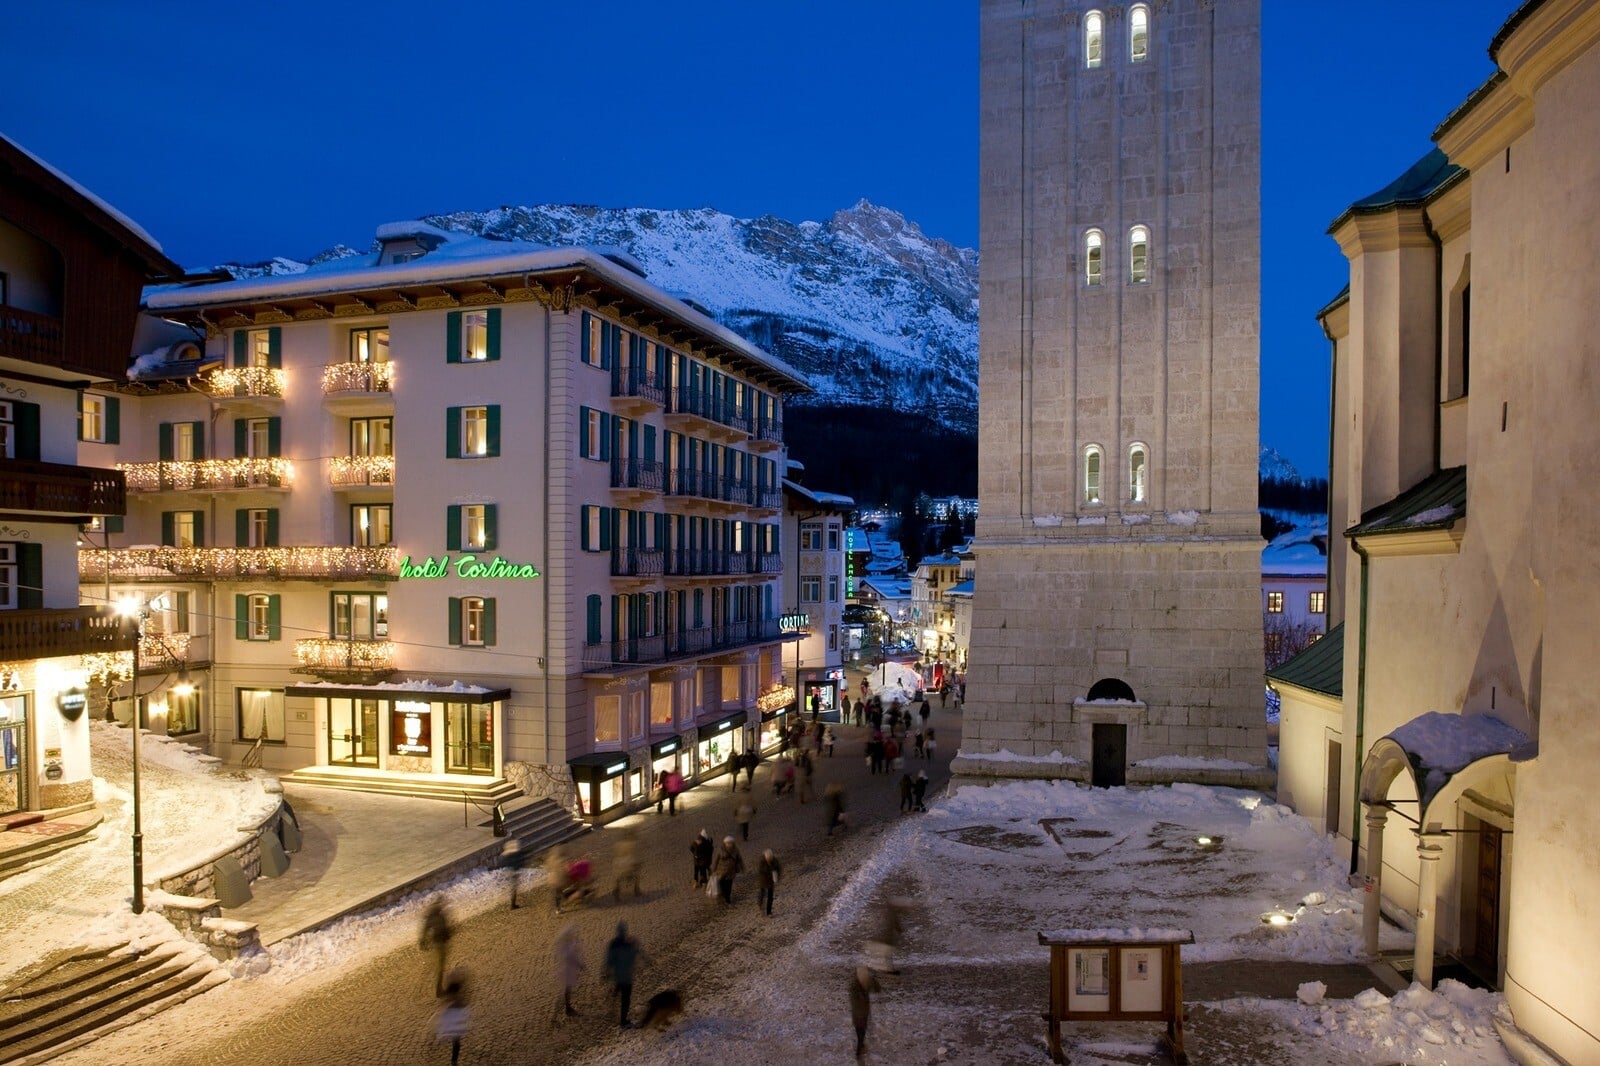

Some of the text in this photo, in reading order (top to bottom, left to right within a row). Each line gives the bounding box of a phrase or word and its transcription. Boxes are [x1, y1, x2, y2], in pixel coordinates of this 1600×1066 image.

[399, 555, 540, 579] hotel Cortina
[779, 614, 810, 630] CORTINA
